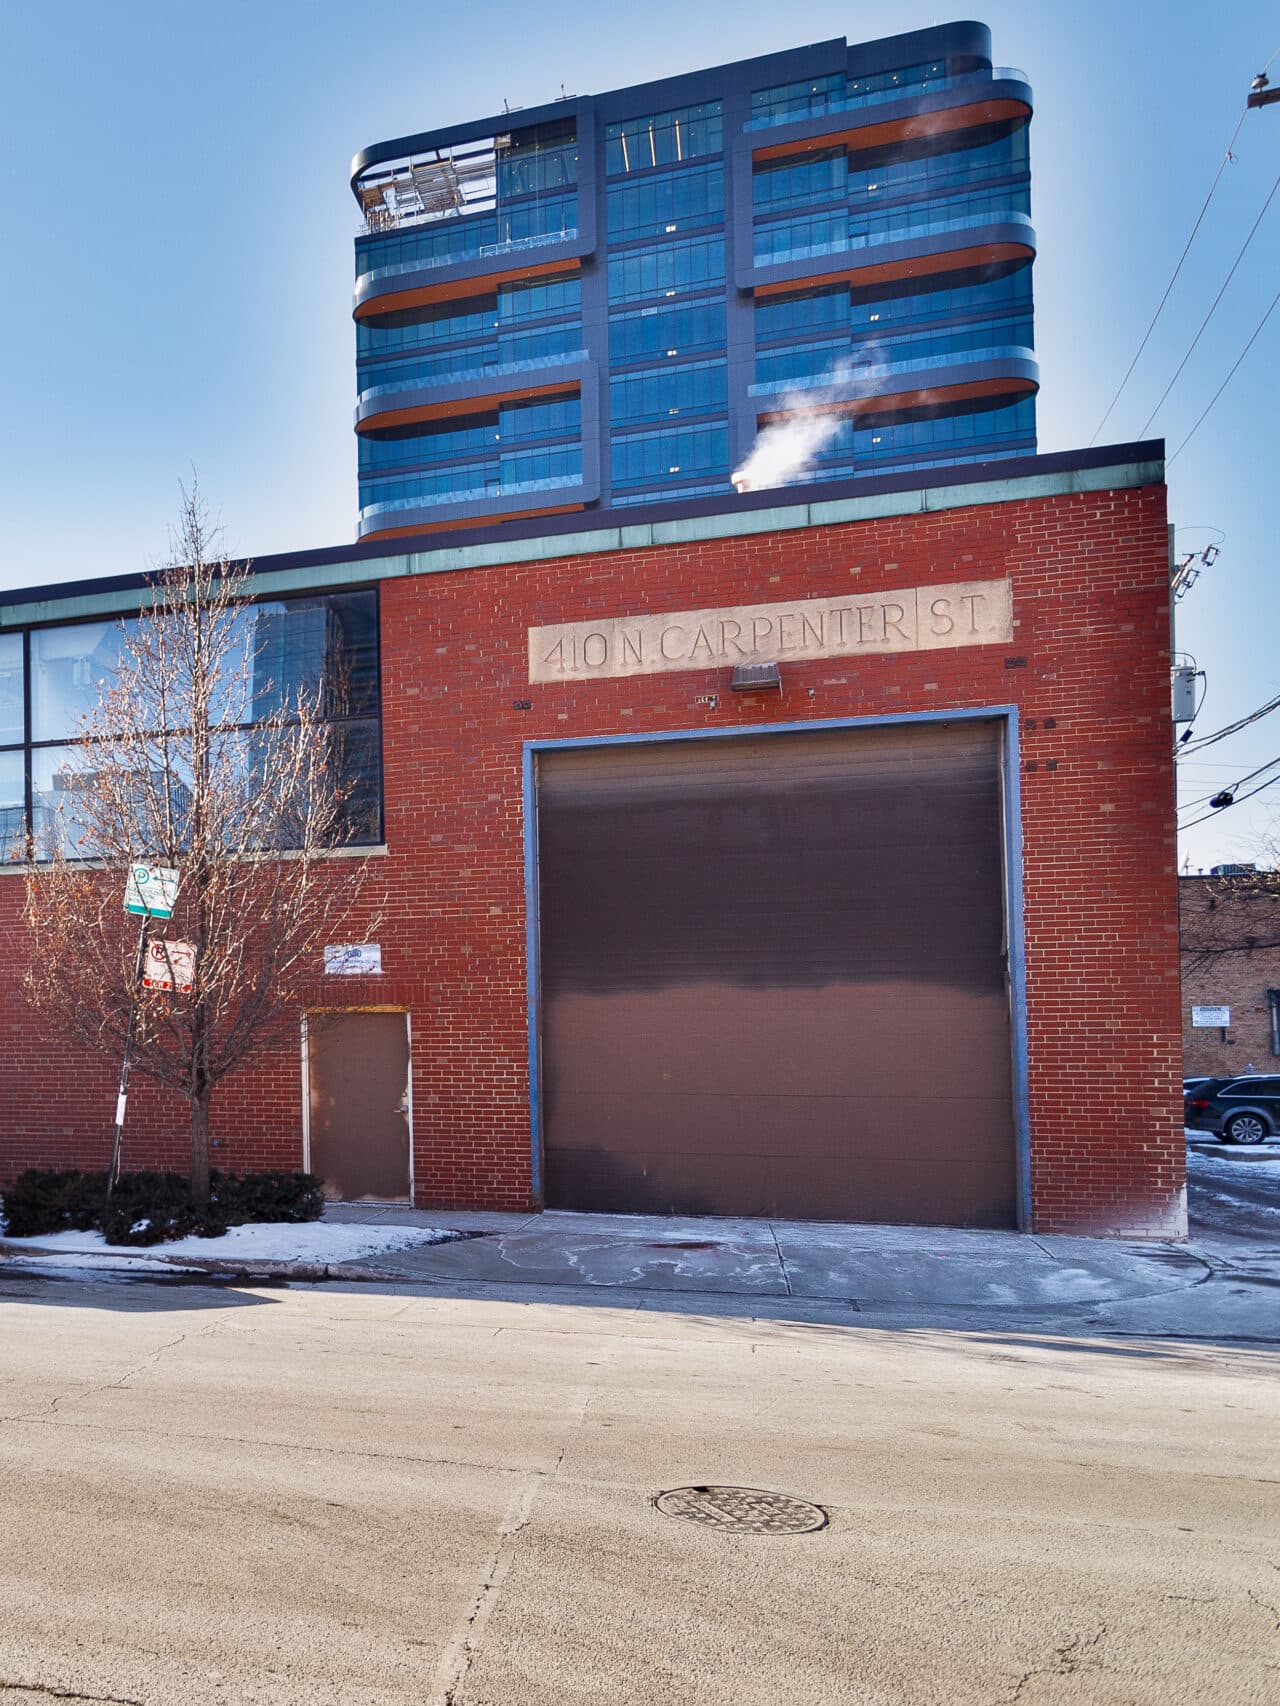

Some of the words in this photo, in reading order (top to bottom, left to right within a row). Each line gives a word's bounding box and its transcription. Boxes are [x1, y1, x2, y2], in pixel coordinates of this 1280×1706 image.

[542, 632, 609, 673] 410
[659, 602, 912, 661] CARPENTER
[930, 594, 997, 636] ST.
